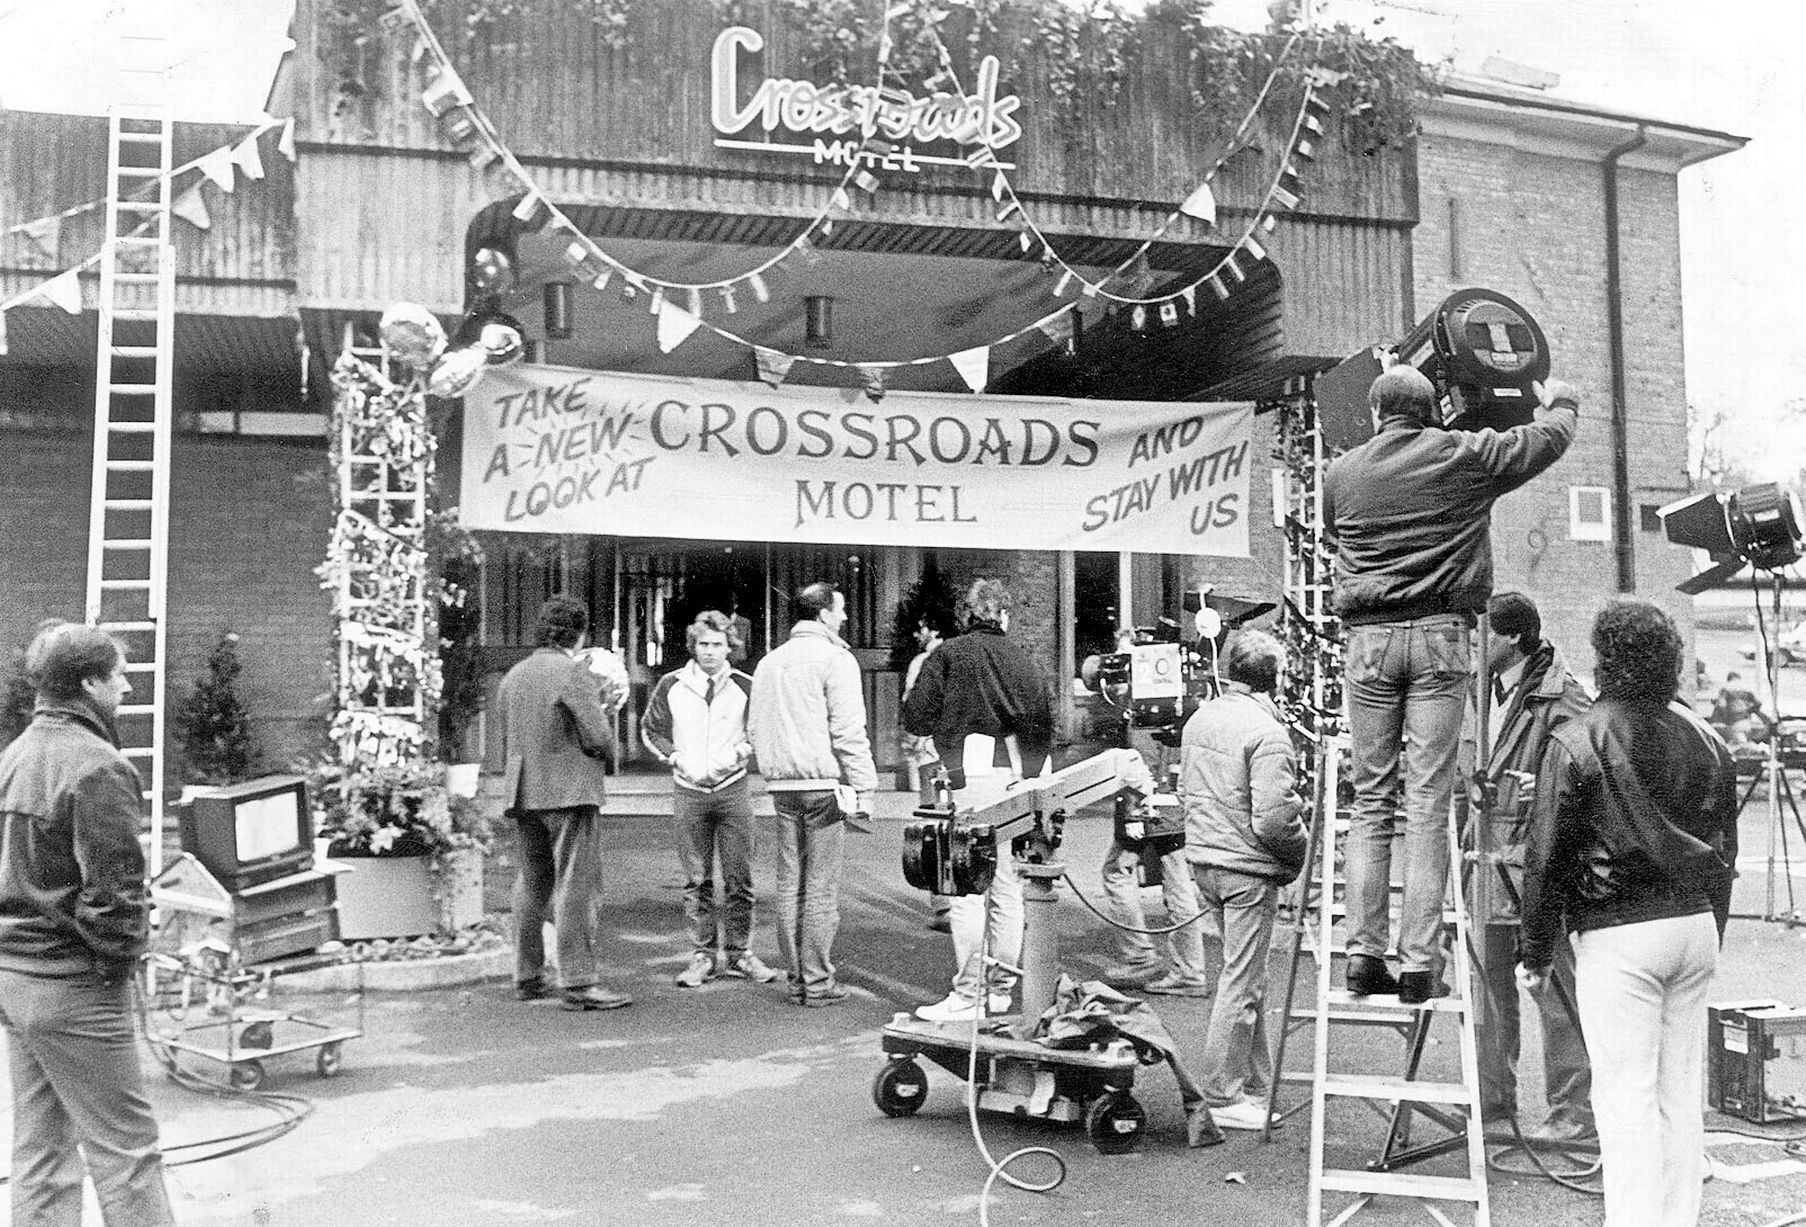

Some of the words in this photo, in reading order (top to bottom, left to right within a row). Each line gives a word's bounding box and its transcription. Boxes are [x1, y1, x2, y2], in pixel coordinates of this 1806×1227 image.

[494, 376, 592, 428] TAKE
[483, 443, 510, 484] A
[534, 412, 632, 468] NEW
[650, 399, 1101, 469] CROSSROADS
[1127, 415, 1205, 468] AND
[506, 468, 600, 522] LOOK
[605, 456, 657, 497] AT
[795, 479, 978, 529] MOTEL
[1082, 473, 1160, 532] STAY
[1168, 440, 1249, 500] WITH
[1190, 493, 1239, 536] US
